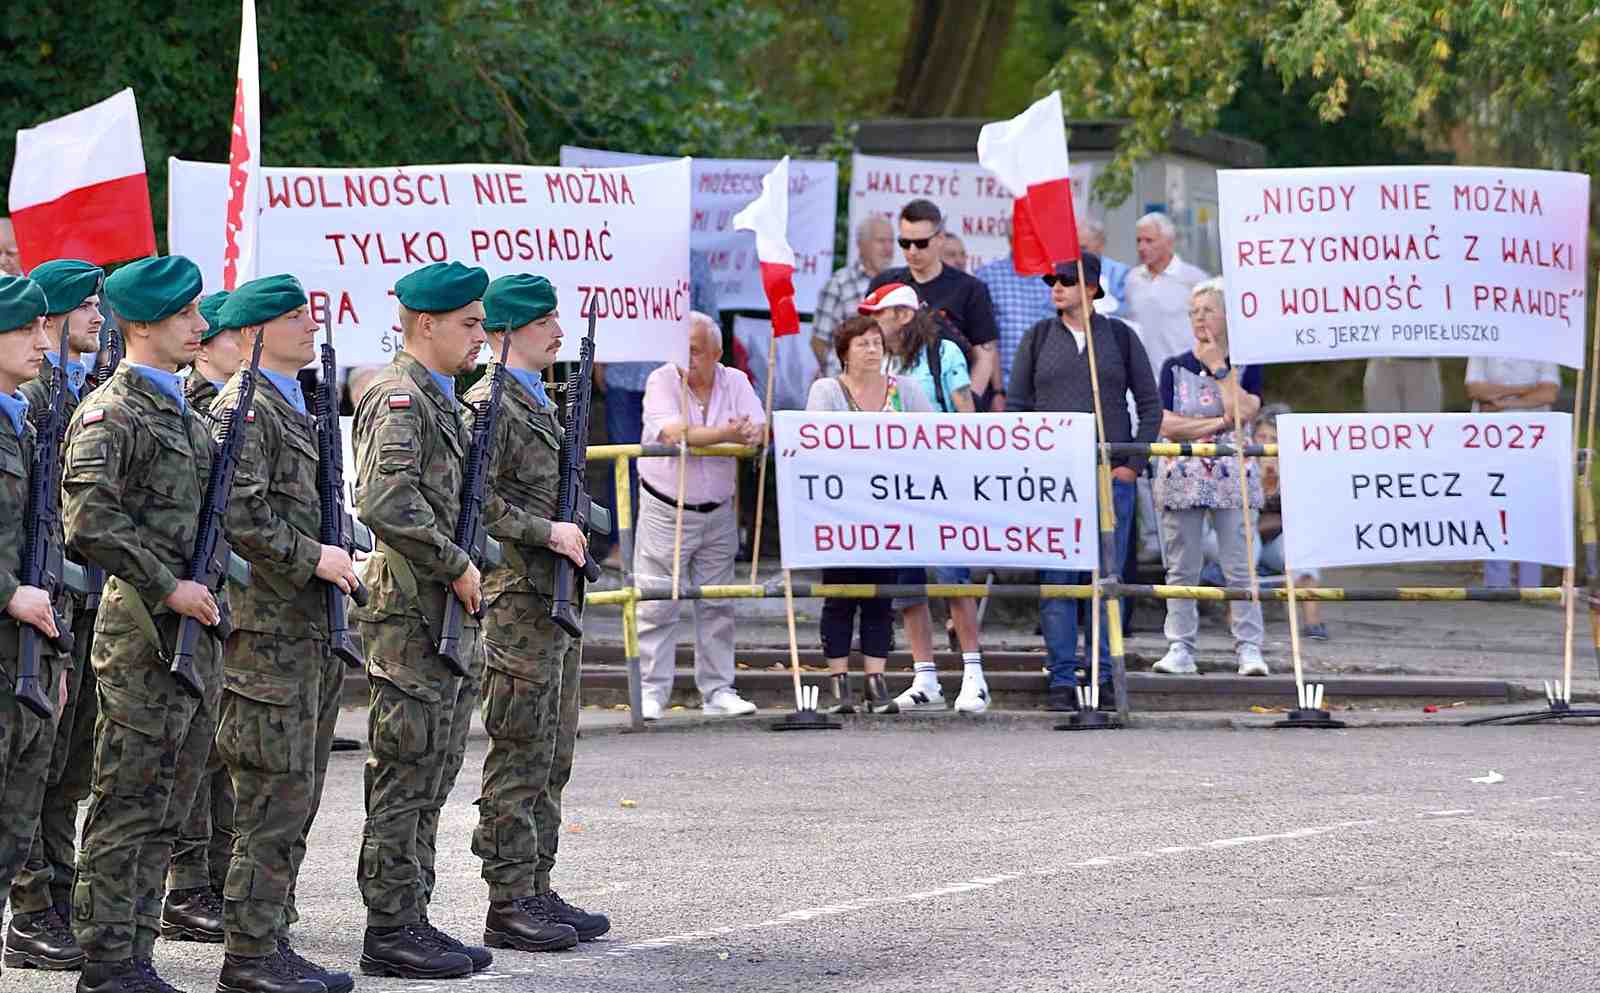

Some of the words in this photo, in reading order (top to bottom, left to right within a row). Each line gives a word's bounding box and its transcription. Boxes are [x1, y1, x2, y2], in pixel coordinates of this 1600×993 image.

[472, 172, 528, 205] NIE
[545, 165, 636, 206] MOŻNA
[1244, 184, 1356, 223] „NIGDY
[1380, 184, 1432, 212] NIE
[1453, 179, 1544, 217] MOŻNA
[325, 231, 448, 266] TYLKO
[471, 221, 614, 262] POSIADAĆ
[961, 207, 1012, 238] NARÓ
[1237, 224, 1441, 268] REZYGNOWAĆ
[1463, 235, 1480, 262] Z
[1501, 237, 1575, 272] WALKI
[1240, 291, 1259, 319] O
[1281, 274, 1424, 316] WOLNOŚĆ
[1445, 284, 1452, 311] I
[1294, 328, 1322, 346] KS.
[1328, 325, 1382, 349] JERZY
[1391, 325, 1500, 343] POPIEŁUSZKO
[1302, 423, 1435, 451] WYBORY
[1461, 424, 1547, 450] 2027
[800, 474, 845, 501] TO
[871, 474, 949, 501] SIŁA
[973, 466, 1079, 503] KTÓRA
[1351, 472, 1463, 500] PRECZ
[1487, 472, 1508, 498] Z
[814, 523, 916, 552] BUDZI
[938, 517, 1082, 560] POLSKĘ!
[1354, 509, 1510, 553] KOMUNĄ!
